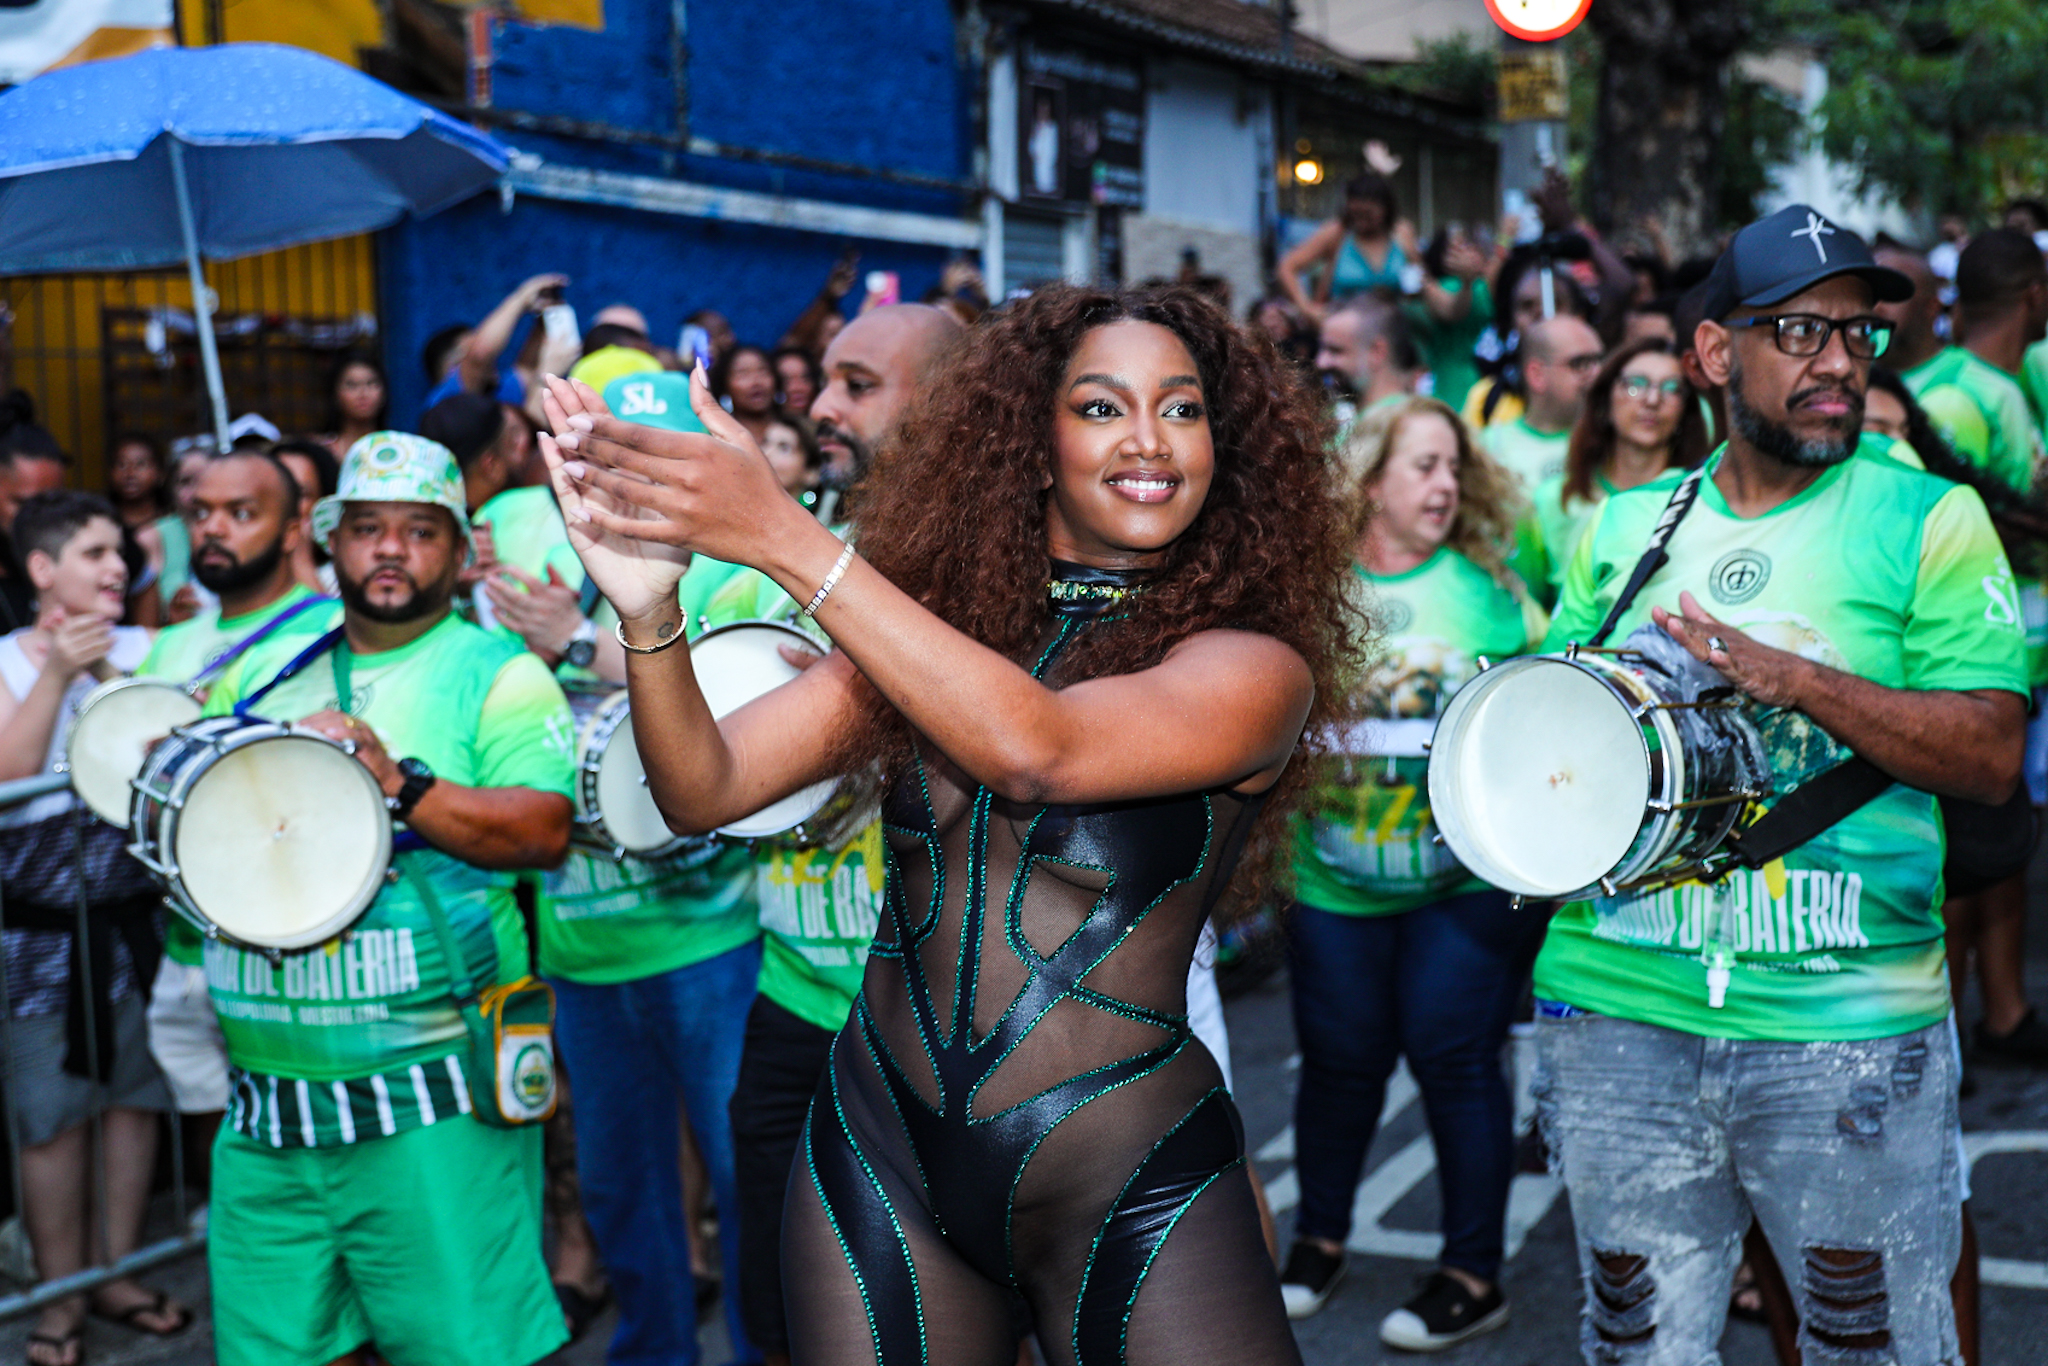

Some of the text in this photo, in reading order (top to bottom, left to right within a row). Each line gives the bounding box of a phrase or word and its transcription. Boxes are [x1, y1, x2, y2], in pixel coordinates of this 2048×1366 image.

[621, 382, 668, 416] SL
[1730, 868, 1869, 953] BATERIA
[283, 927, 420, 1001] BATERIA
